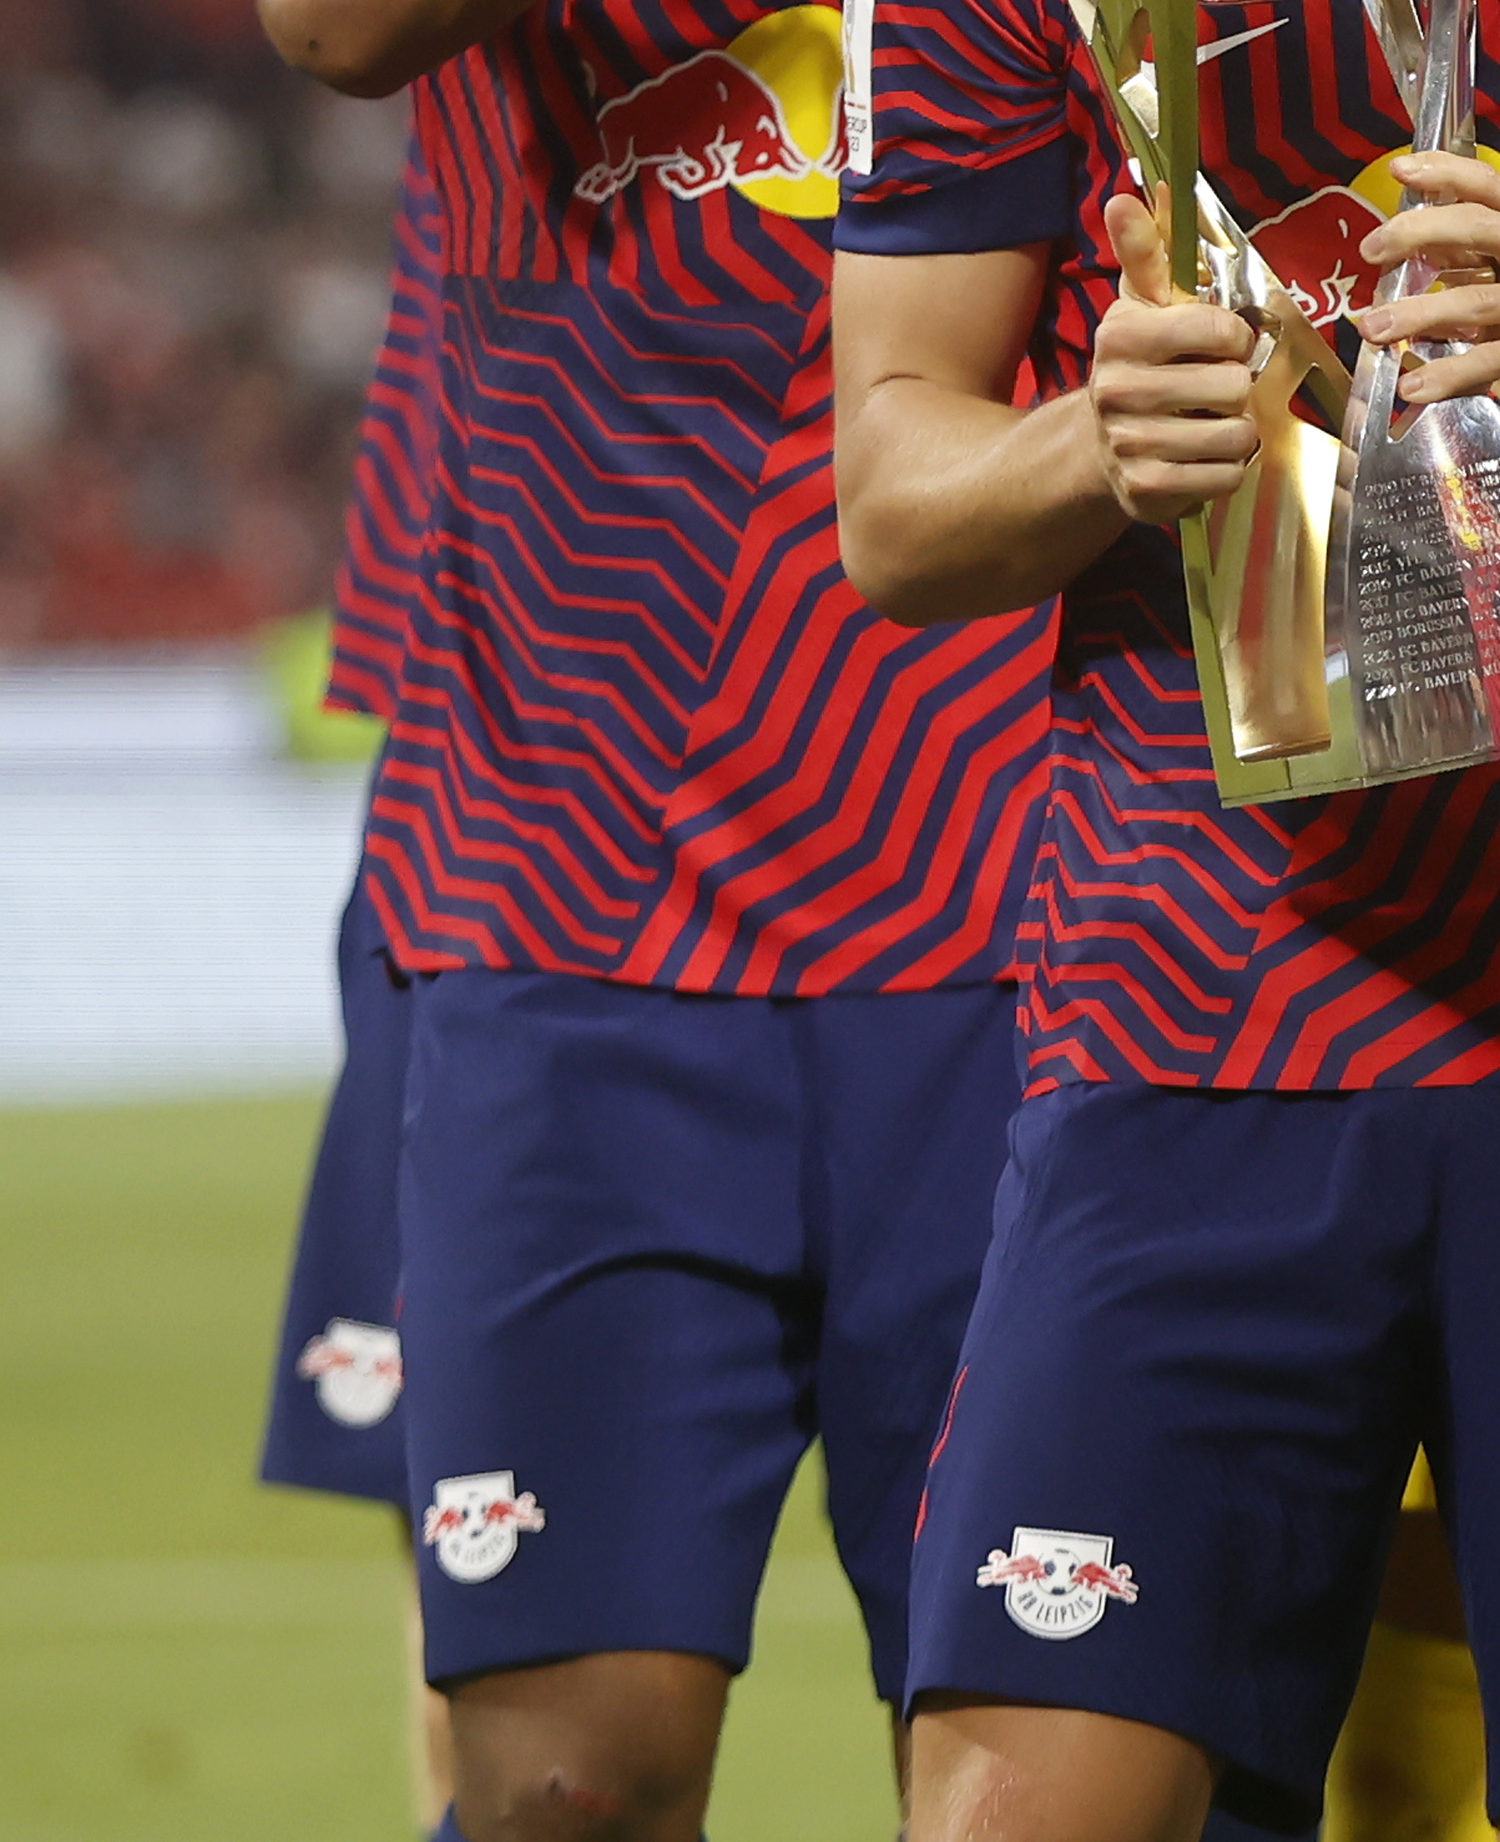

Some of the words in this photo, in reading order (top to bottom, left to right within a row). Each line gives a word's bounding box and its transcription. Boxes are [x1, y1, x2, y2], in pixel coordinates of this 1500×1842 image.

[1358, 577, 1391, 596] 2016
[1396, 572, 1414, 587] FC
[1396, 608, 1416, 622] FC
[1419, 596, 1470, 617] BAYERN
[1397, 615, 1464, 638] BORUSSIA
[1399, 644, 1418, 658] FC
[1400, 660, 1419, 675] FC
[1421, 650, 1474, 671] BAYERN
[1424, 667, 1477, 690] BAYERN
[1036, 1595, 1093, 1625] LEIPZIG
